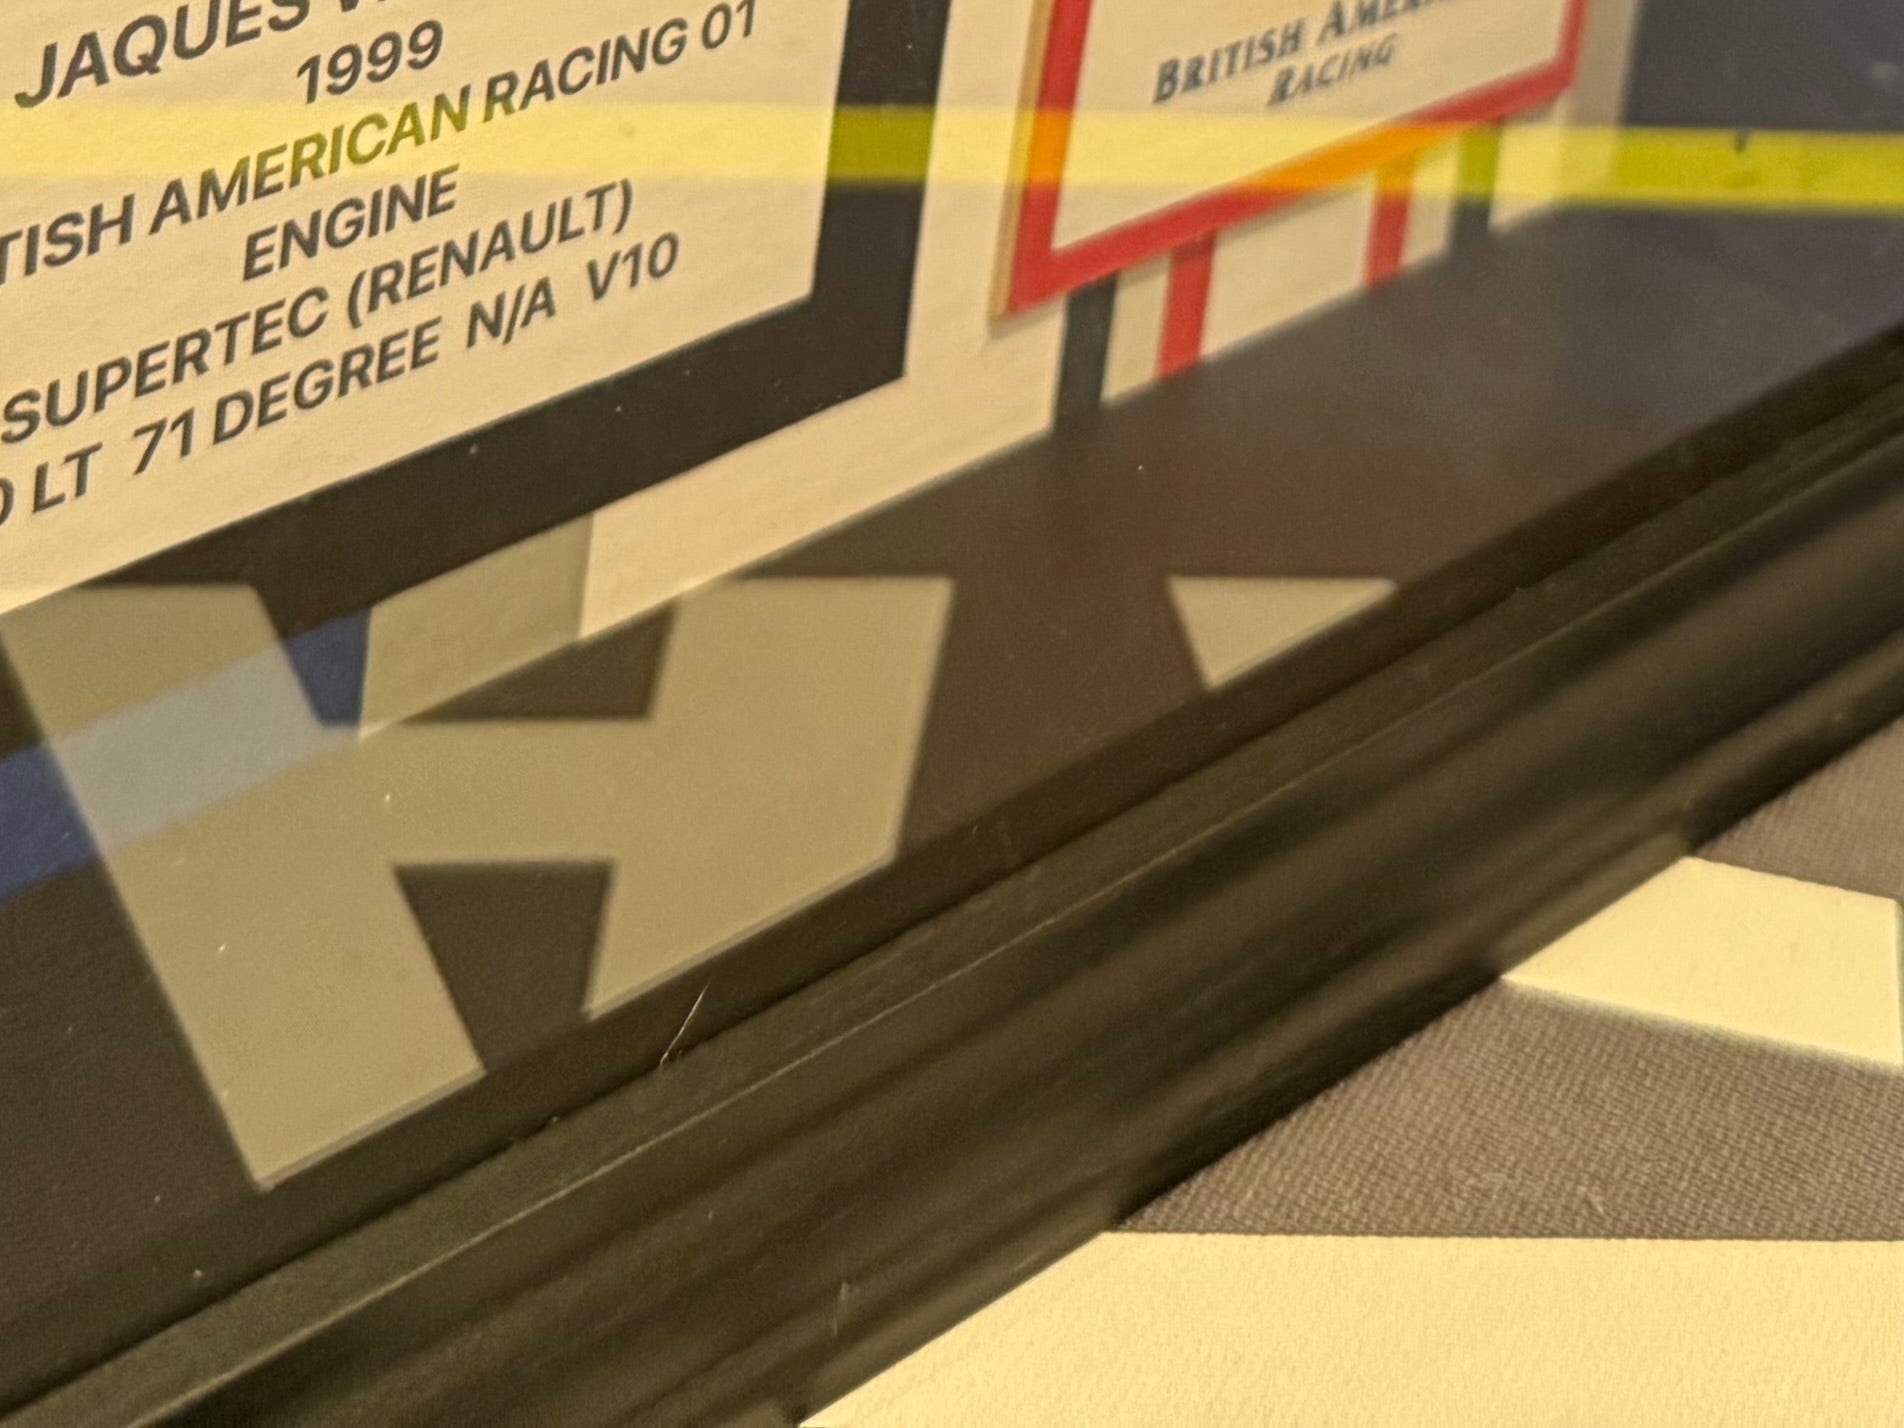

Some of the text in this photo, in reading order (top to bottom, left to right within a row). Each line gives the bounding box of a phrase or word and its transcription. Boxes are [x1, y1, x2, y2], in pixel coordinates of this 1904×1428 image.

[296, 19, 444, 105] 1999
[1152, 20, 1308, 105] BRITISH
[1267, 34, 1398, 108] RACING
[148, 82, 471, 235] AMERICAN
[482, 16, 688, 123] RACING
[242, 163, 460, 282] ENGINE
[0, 178, 634, 444] SUPERTEC (RENAULT)
[32, 442, 104, 514] LT
[132, 407, 195, 475] 71
[212, 315, 443, 444] DEGREE
[466, 275, 557, 349] N/A
[586, 231, 681, 302] V10
